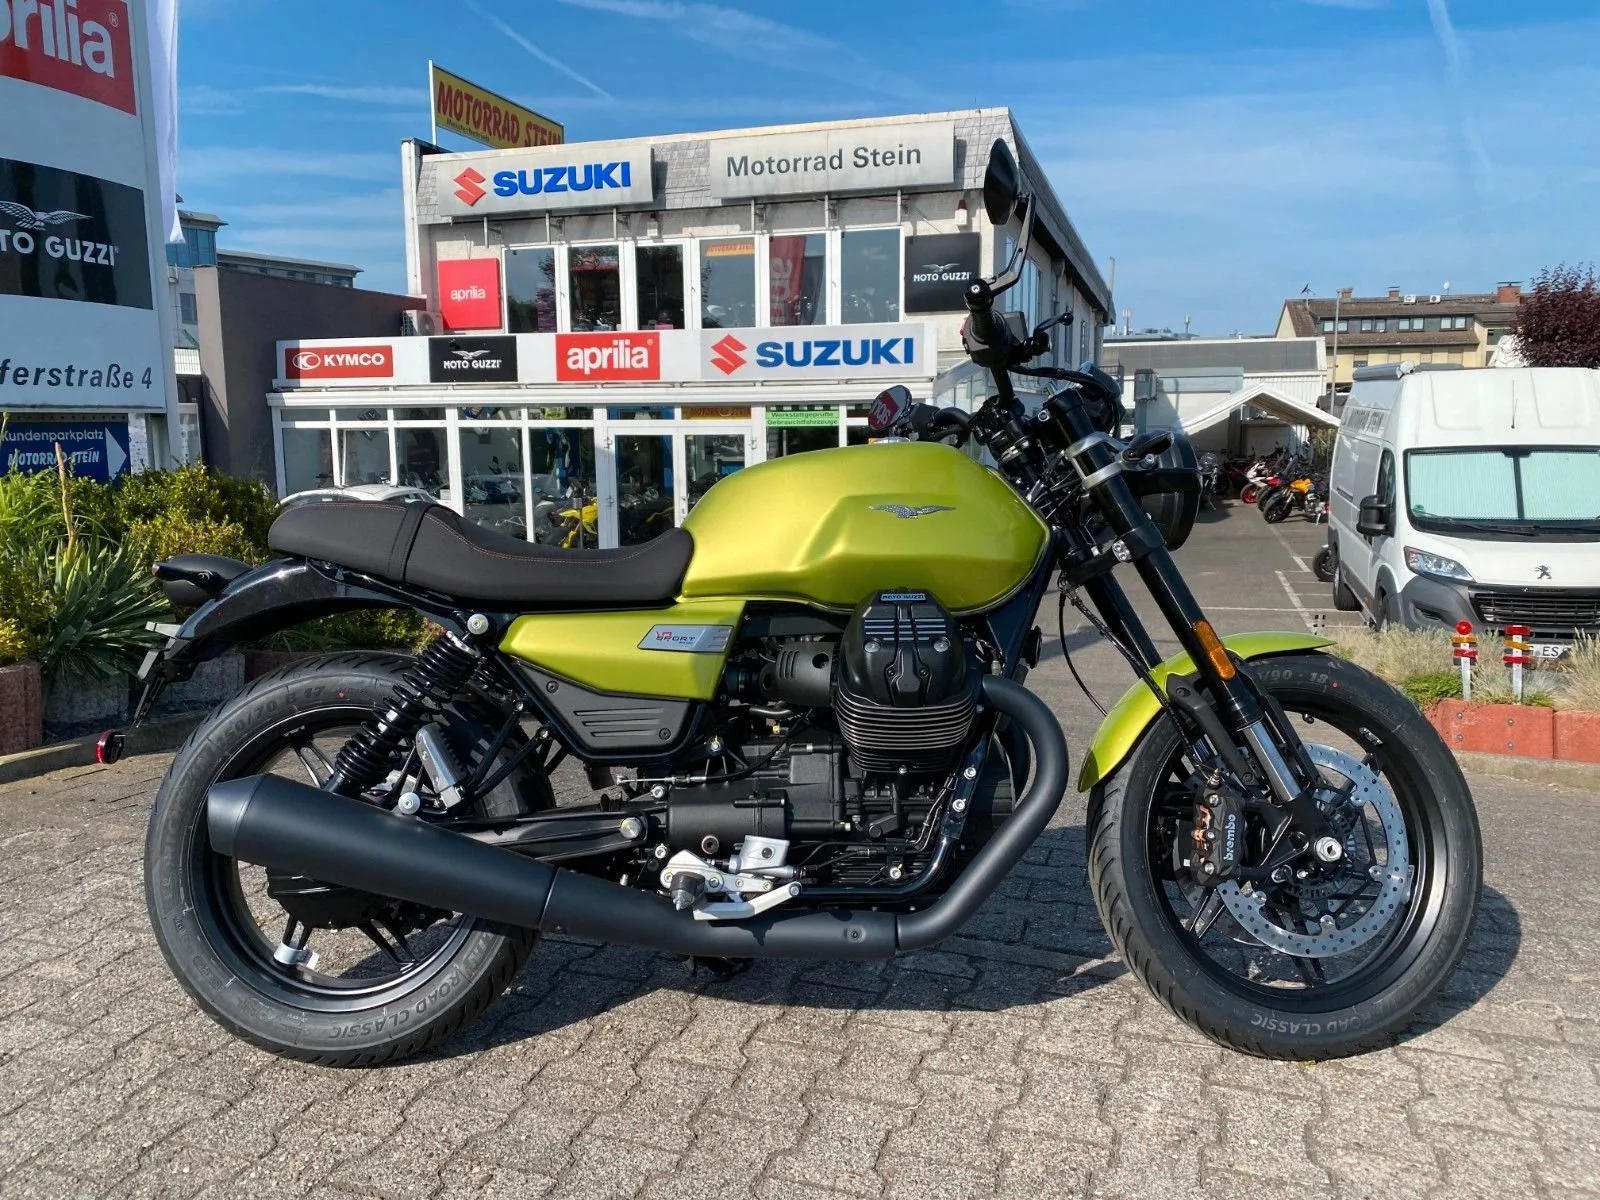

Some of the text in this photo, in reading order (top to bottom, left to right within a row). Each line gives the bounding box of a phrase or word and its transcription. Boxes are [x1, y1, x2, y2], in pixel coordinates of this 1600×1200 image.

[437, 80, 520, 144] MOTORRAD
[726, 144, 921, 177] Motorrad Stein
[493, 161, 631, 197] SUZUKI
[45, 236, 115, 266] GUZZI
[913, 271, 970, 282] MOTO GUZZI
[450, 284, 486, 302] aprilia
[324, 353, 385, 367] KYMCO
[443, 359, 500, 369] MOTO GUZZI
[566, 338, 649, 377] aprilia
[756, 337, 915, 368] SUZUKI
[141, 366, 153, 389] 4
[2, 428, 104, 442] Kundenparkplatz
[1223, 813, 1237, 861] brembo
[328, 970, 462, 1039] ROAD CLASSIC
[1250, 1012, 1322, 1036] CLASSIC
